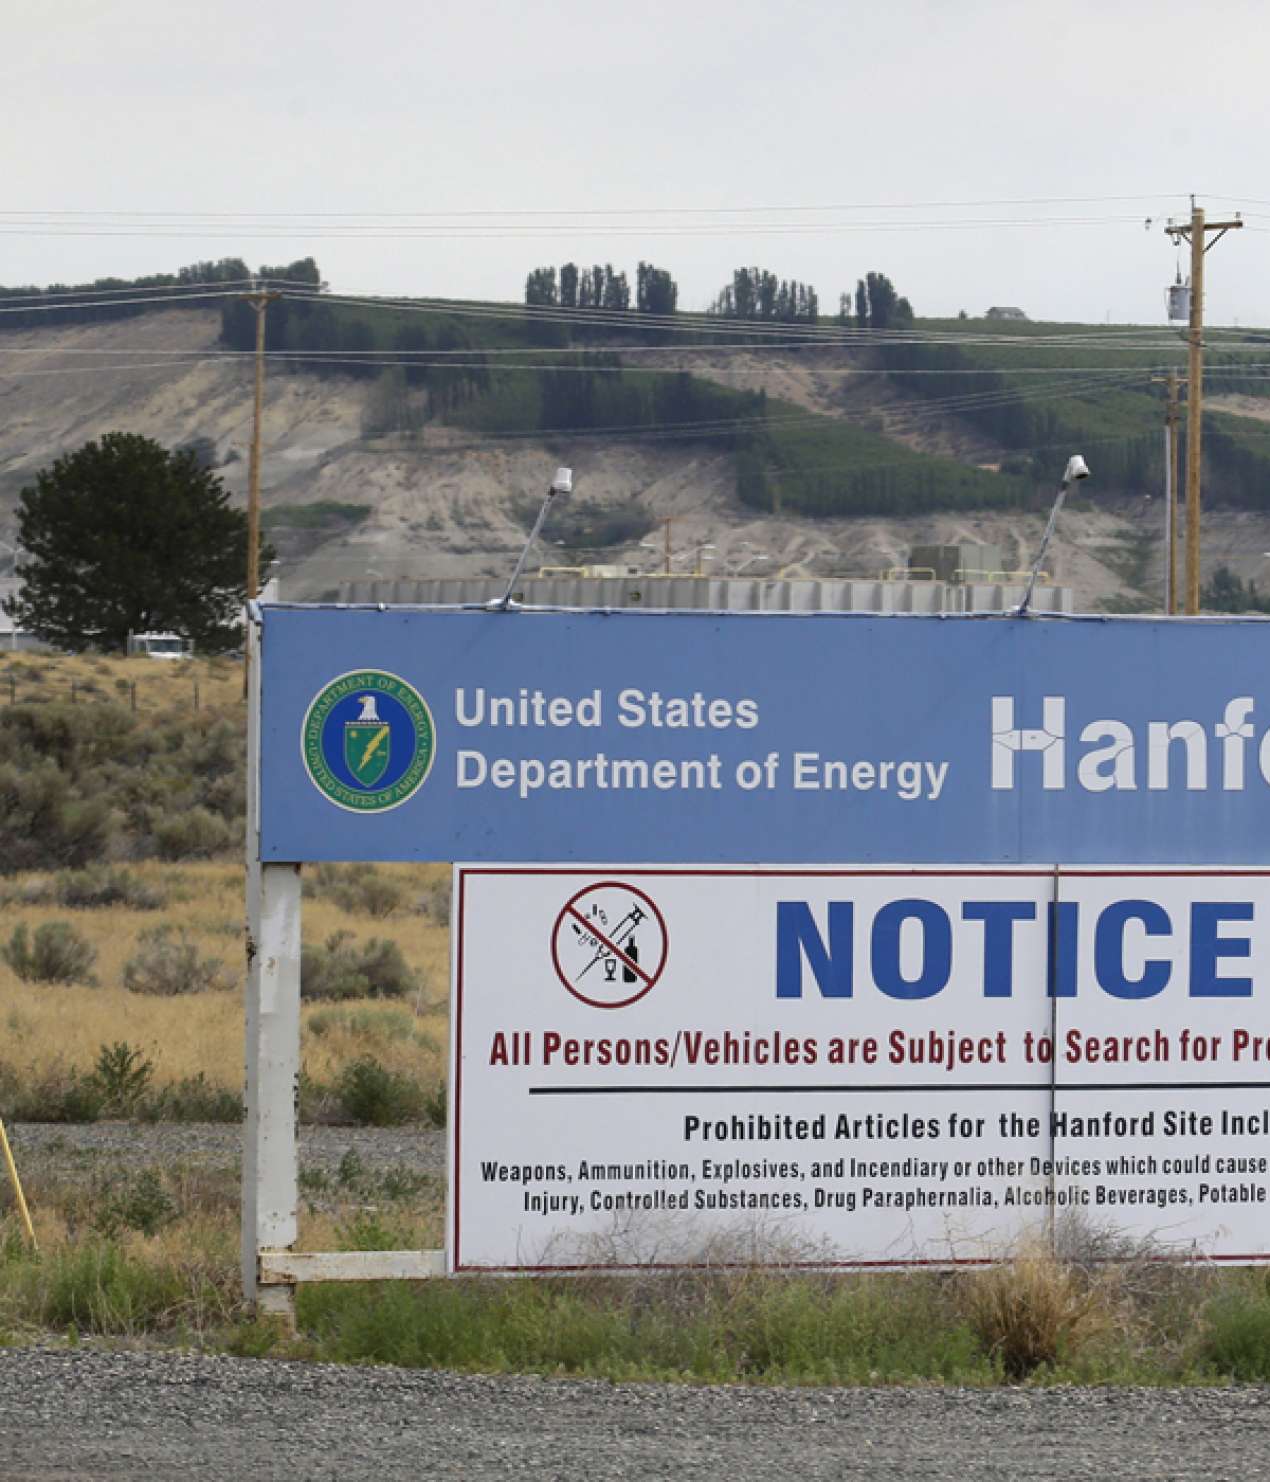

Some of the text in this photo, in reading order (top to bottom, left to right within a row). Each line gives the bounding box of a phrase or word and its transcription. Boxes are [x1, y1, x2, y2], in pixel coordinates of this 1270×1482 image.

[378, 677, 396, 690] OF
[456, 687, 759, 729] United States
[456, 750, 949, 798] Department of Energy
[775, 899, 1254, 1001] NOTICE
[488, 1031, 531, 1066] All
[543, 1030, 818, 1068] Persons/Vehicles
[827, 1038, 878, 1064] are
[888, 1030, 1006, 1072] Subject
[1023, 1031, 1054, 1065] to
[1065, 1028, 1169, 1064] Search
[1178, 1028, 1221, 1062] for
[684, 1114, 826, 1142] Prohibited
[835, 1113, 940, 1140] Articles
[947, 1112, 985, 1138] for
[998, 1112, 1040, 1138] the
[1050, 1111, 1156, 1138] Hanford
[1163, 1110, 1212, 1136] Site
[481, 1161, 573, 1186] Weapons,
[577, 1159, 696, 1182] Ammunition,
[702, 1159, 805, 1184] Explosives,
[810, 1157, 844, 1178] and
[850, 1157, 949, 1182] Incendiary
[953, 1161, 972, 1178] or
[977, 1157, 1025, 1178] other
[1029, 1156, 1102, 1177] Devices
[1106, 1155, 1157, 1176] which
[1161, 1154, 1210, 1174] could
[1216, 1157, 1267, 1174] cause
[524, 1191, 585, 1216] Injury,
[590, 1189, 689, 1212] Controlled
[694, 1189, 809, 1210] Substances,
[814, 1187, 856, 1212] Drug
[862, 1186, 998, 1212] Paraphernalia,
[1004, 1186, 1091, 1207] Alcoholic
[1095, 1185, 1193, 1209] Beverages,
[1199, 1183, 1267, 1204] Potable
